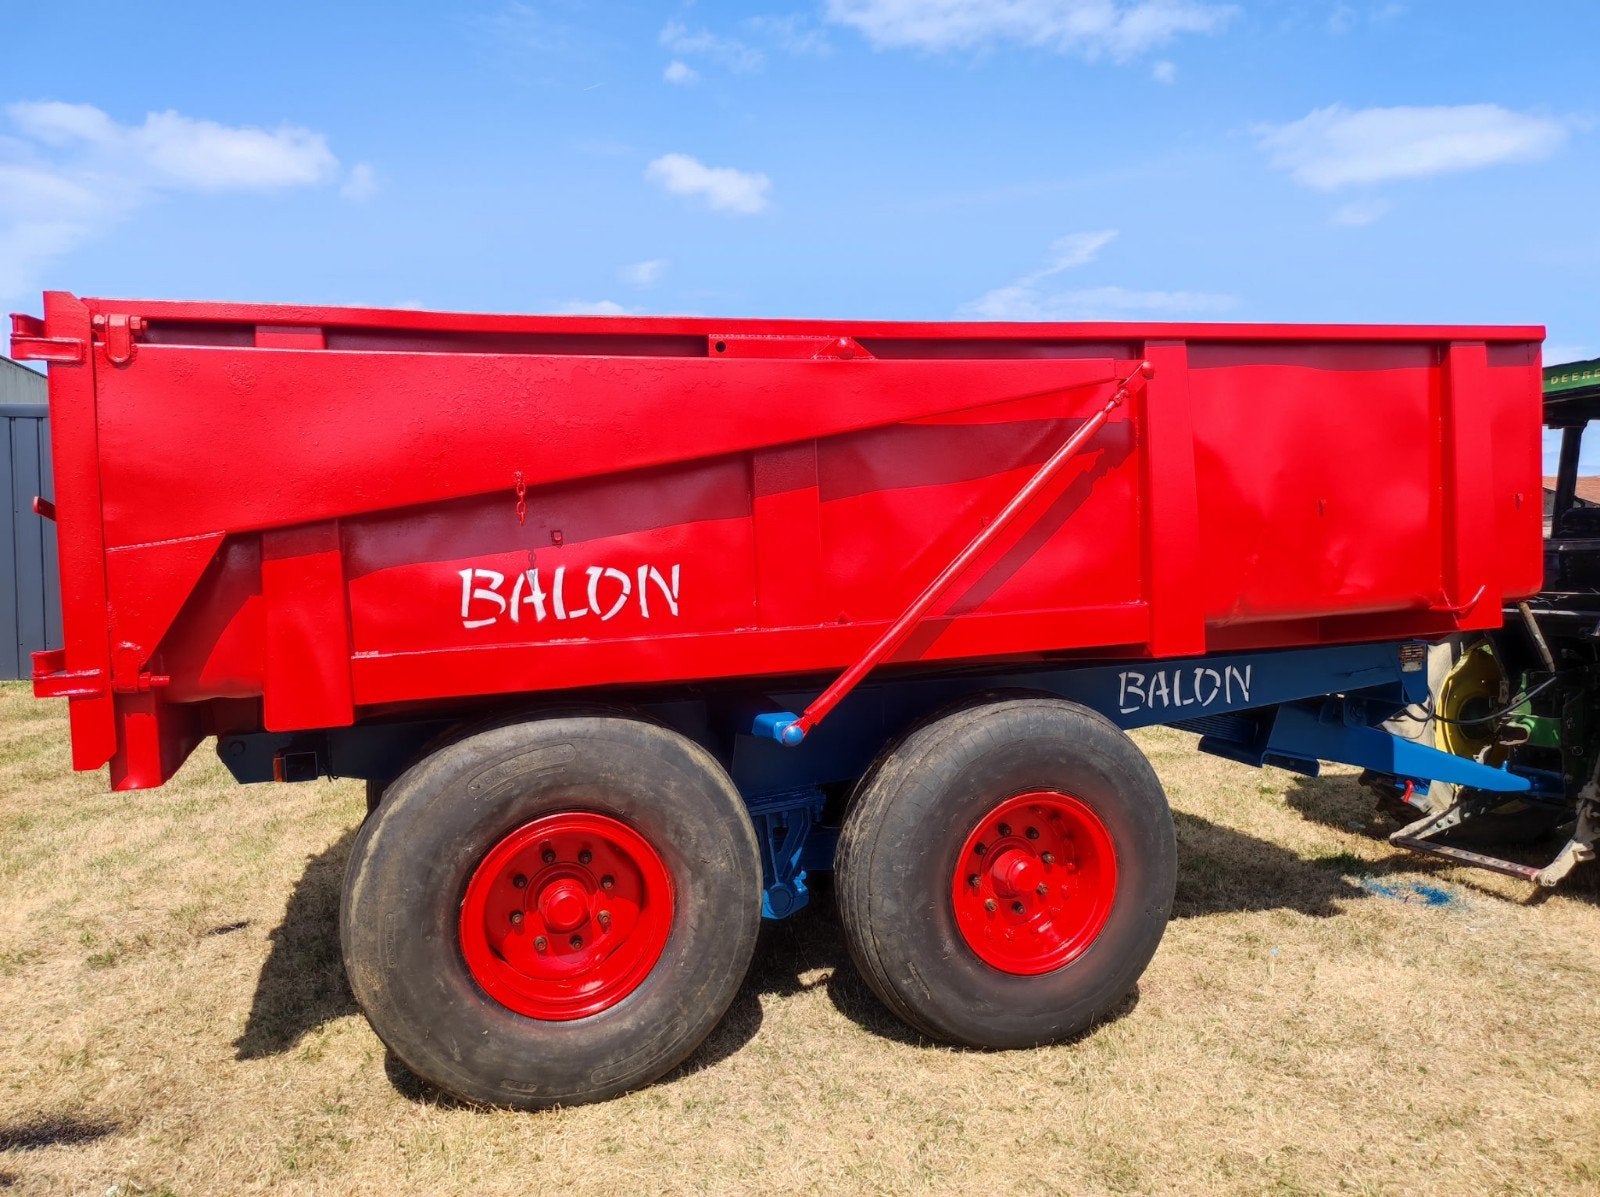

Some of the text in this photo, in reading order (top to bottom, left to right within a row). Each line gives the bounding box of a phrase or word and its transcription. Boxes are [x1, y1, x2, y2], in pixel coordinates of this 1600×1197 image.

[1550, 368, 1600, 385] DEERE
[458, 563, 681, 629] BALON
[1118, 664, 1252, 714] BALON
